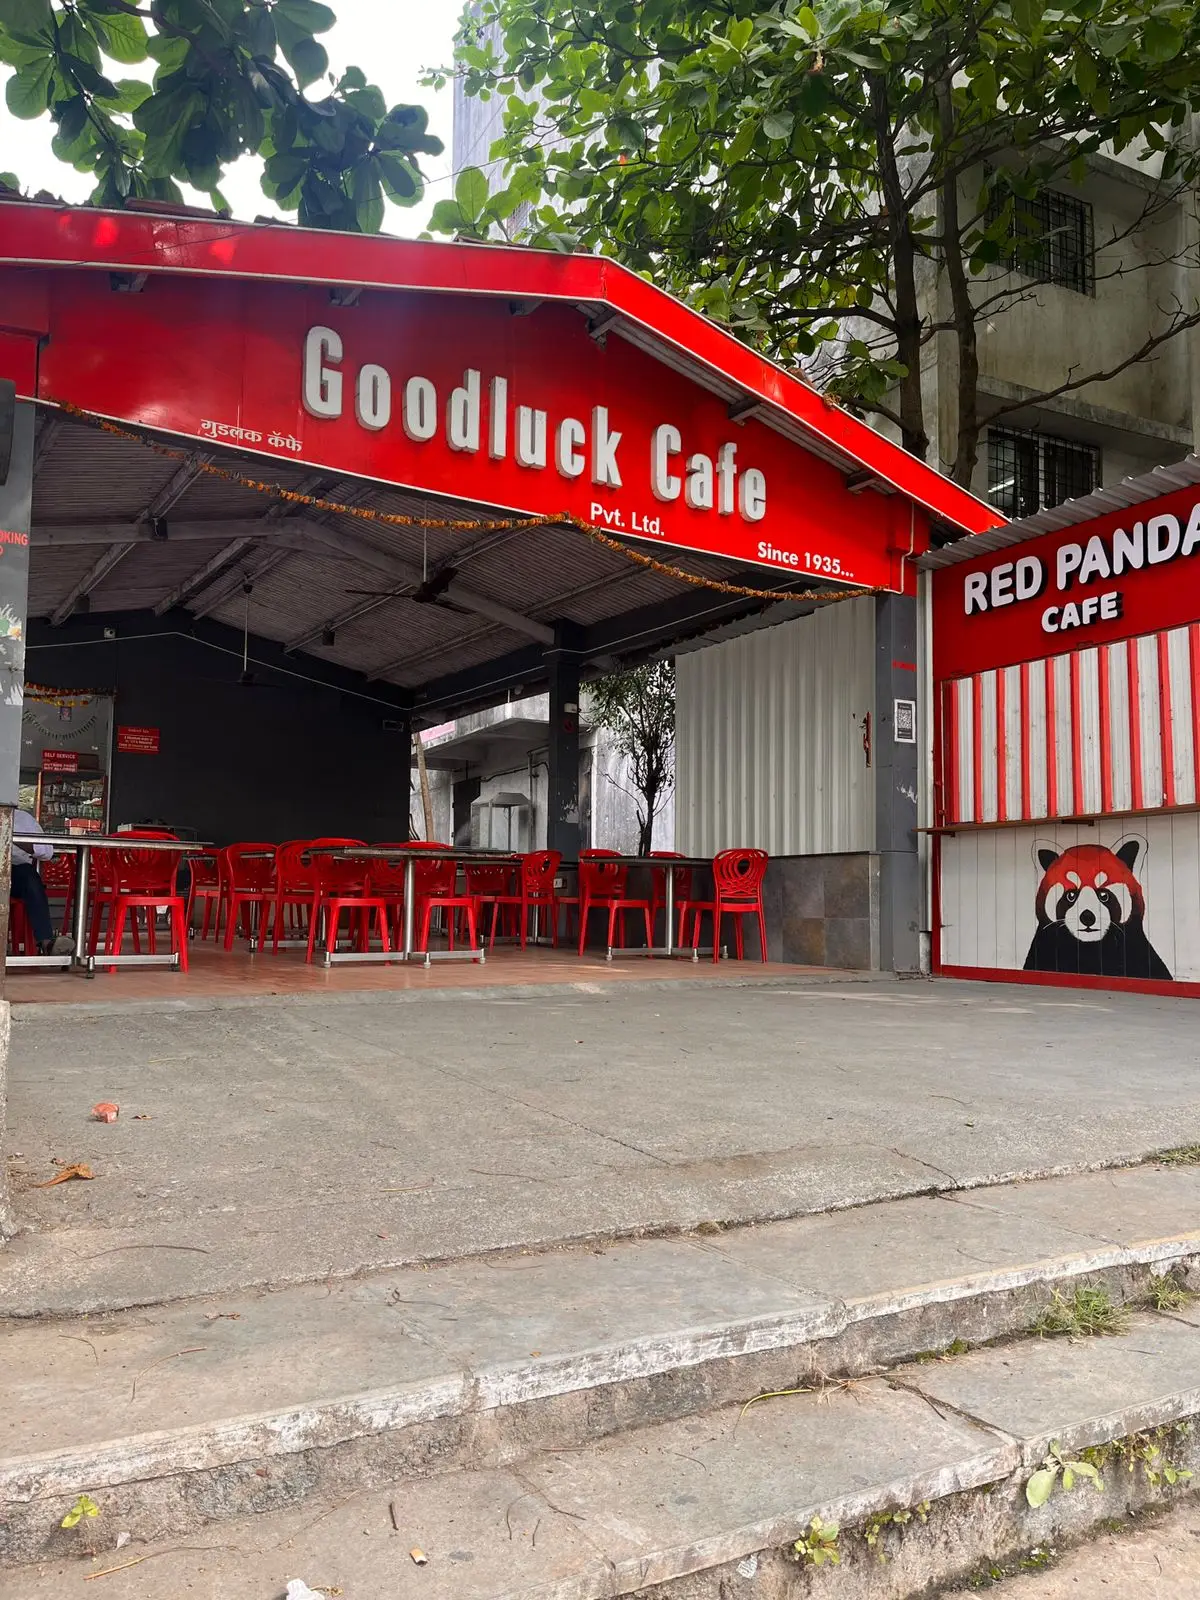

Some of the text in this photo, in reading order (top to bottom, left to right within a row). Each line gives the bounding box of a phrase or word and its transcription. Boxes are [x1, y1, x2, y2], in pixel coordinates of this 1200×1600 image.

[201, 419, 303, 452] गुडलक कॅफे
[303, 326, 767, 523] Goodluck Cafe
[590, 503, 665, 536] Pvt. Ltd.
[757, 541, 854, 578] Since 1935...
[965, 502, 1200, 615] RED PANDA
[1041, 591, 1118, 633] CAFE
